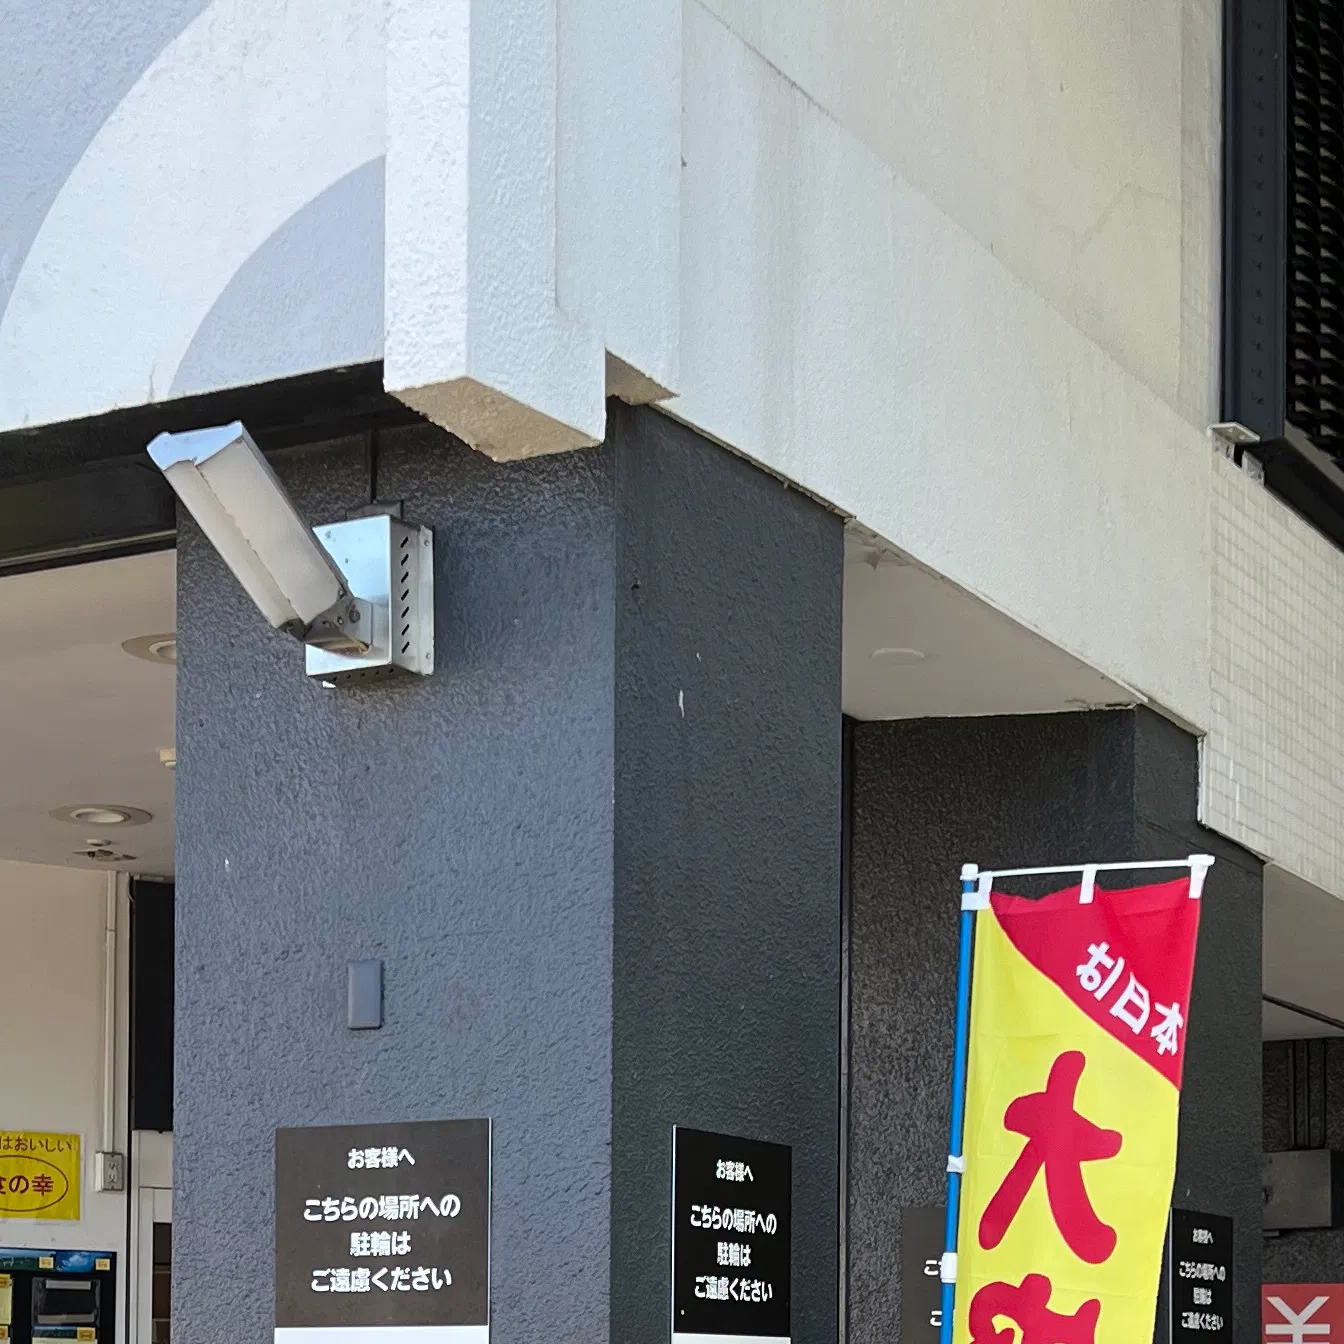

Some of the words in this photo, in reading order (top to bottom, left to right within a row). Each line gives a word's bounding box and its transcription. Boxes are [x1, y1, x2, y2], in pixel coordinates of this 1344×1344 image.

[348, 1147, 415, 1169] お客様へ
[716, 1158, 753, 1182] お客様へ
[303, 1194, 461, 1221] こちらの場所への
[690, 1204, 777, 1235] こちらの場所への
[350, 1231, 411, 1257] 駐輪は
[717, 1242, 751, 1267] 駐輪は
[311, 1267, 452, 1293] ご遠慮ください
[694, 1275, 772, 1302] ご遠慮ください
